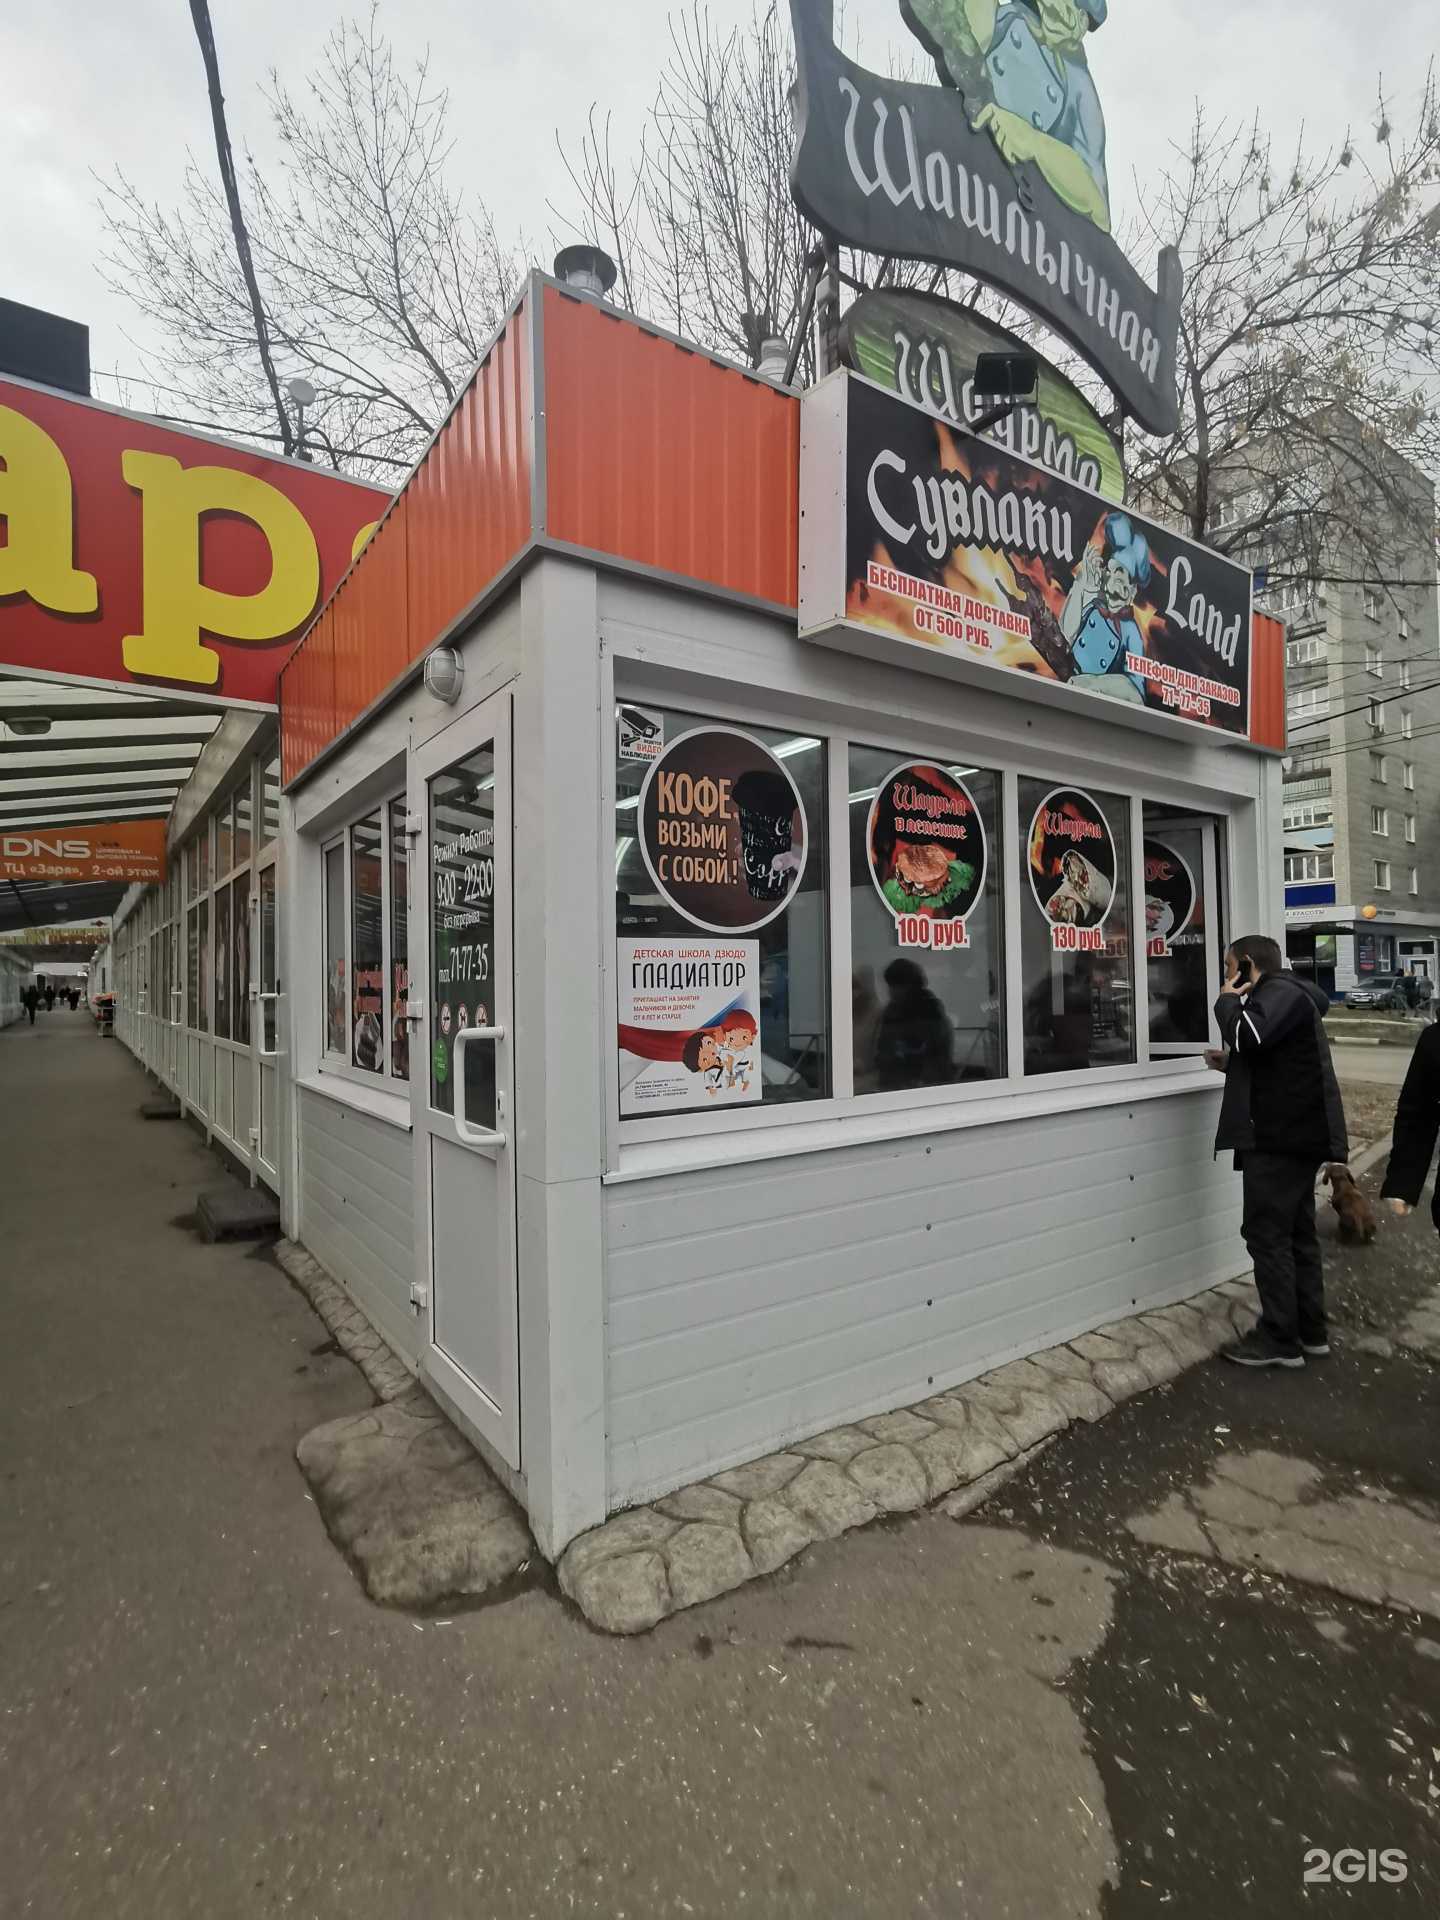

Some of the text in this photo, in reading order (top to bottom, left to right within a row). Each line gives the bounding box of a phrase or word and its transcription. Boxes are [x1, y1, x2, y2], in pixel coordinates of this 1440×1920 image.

[838, 76, 1161, 383] Шашлычная
[867, 449, 1074, 563] Сувлаки
[869, 565, 1030, 637] БЕСПЛАТНАЯ ДОСТАВКА
[1165, 555, 1242, 668] Land
[915, 608, 992, 649] ОТ 500 РУБ.
[1127, 654, 1240, 706] ТЕЛЕФОН ДЛЯ ЗАКАЗОВ
[636, 743, 662, 753] ВИДЕО
[893, 782, 967, 818] Шаурма
[3, 838, 91, 859] DNS
[433, 826, 494, 864] Режим Работы
[658, 819, 727, 850] ВОЗЬМИ
[4, 863, 26, 876] ТЦ
[92, 865, 124, 876] 2-ой
[127, 867, 160, 877] этаж
[436, 871, 456, 907] 9:00
[464, 858, 494, 901] 22:00
[659, 854, 669, 882] С
[453, 911, 480, 928] перерыва
[898, 917, 968, 946] 100 руб.
[1053, 926, 1105, 950] 130 руб.
[633, 949, 746, 960] ДЕТСКАЯ ШКОЛА ДЗЮДО
[632, 962, 746, 990] ГЛАДИАТОР
